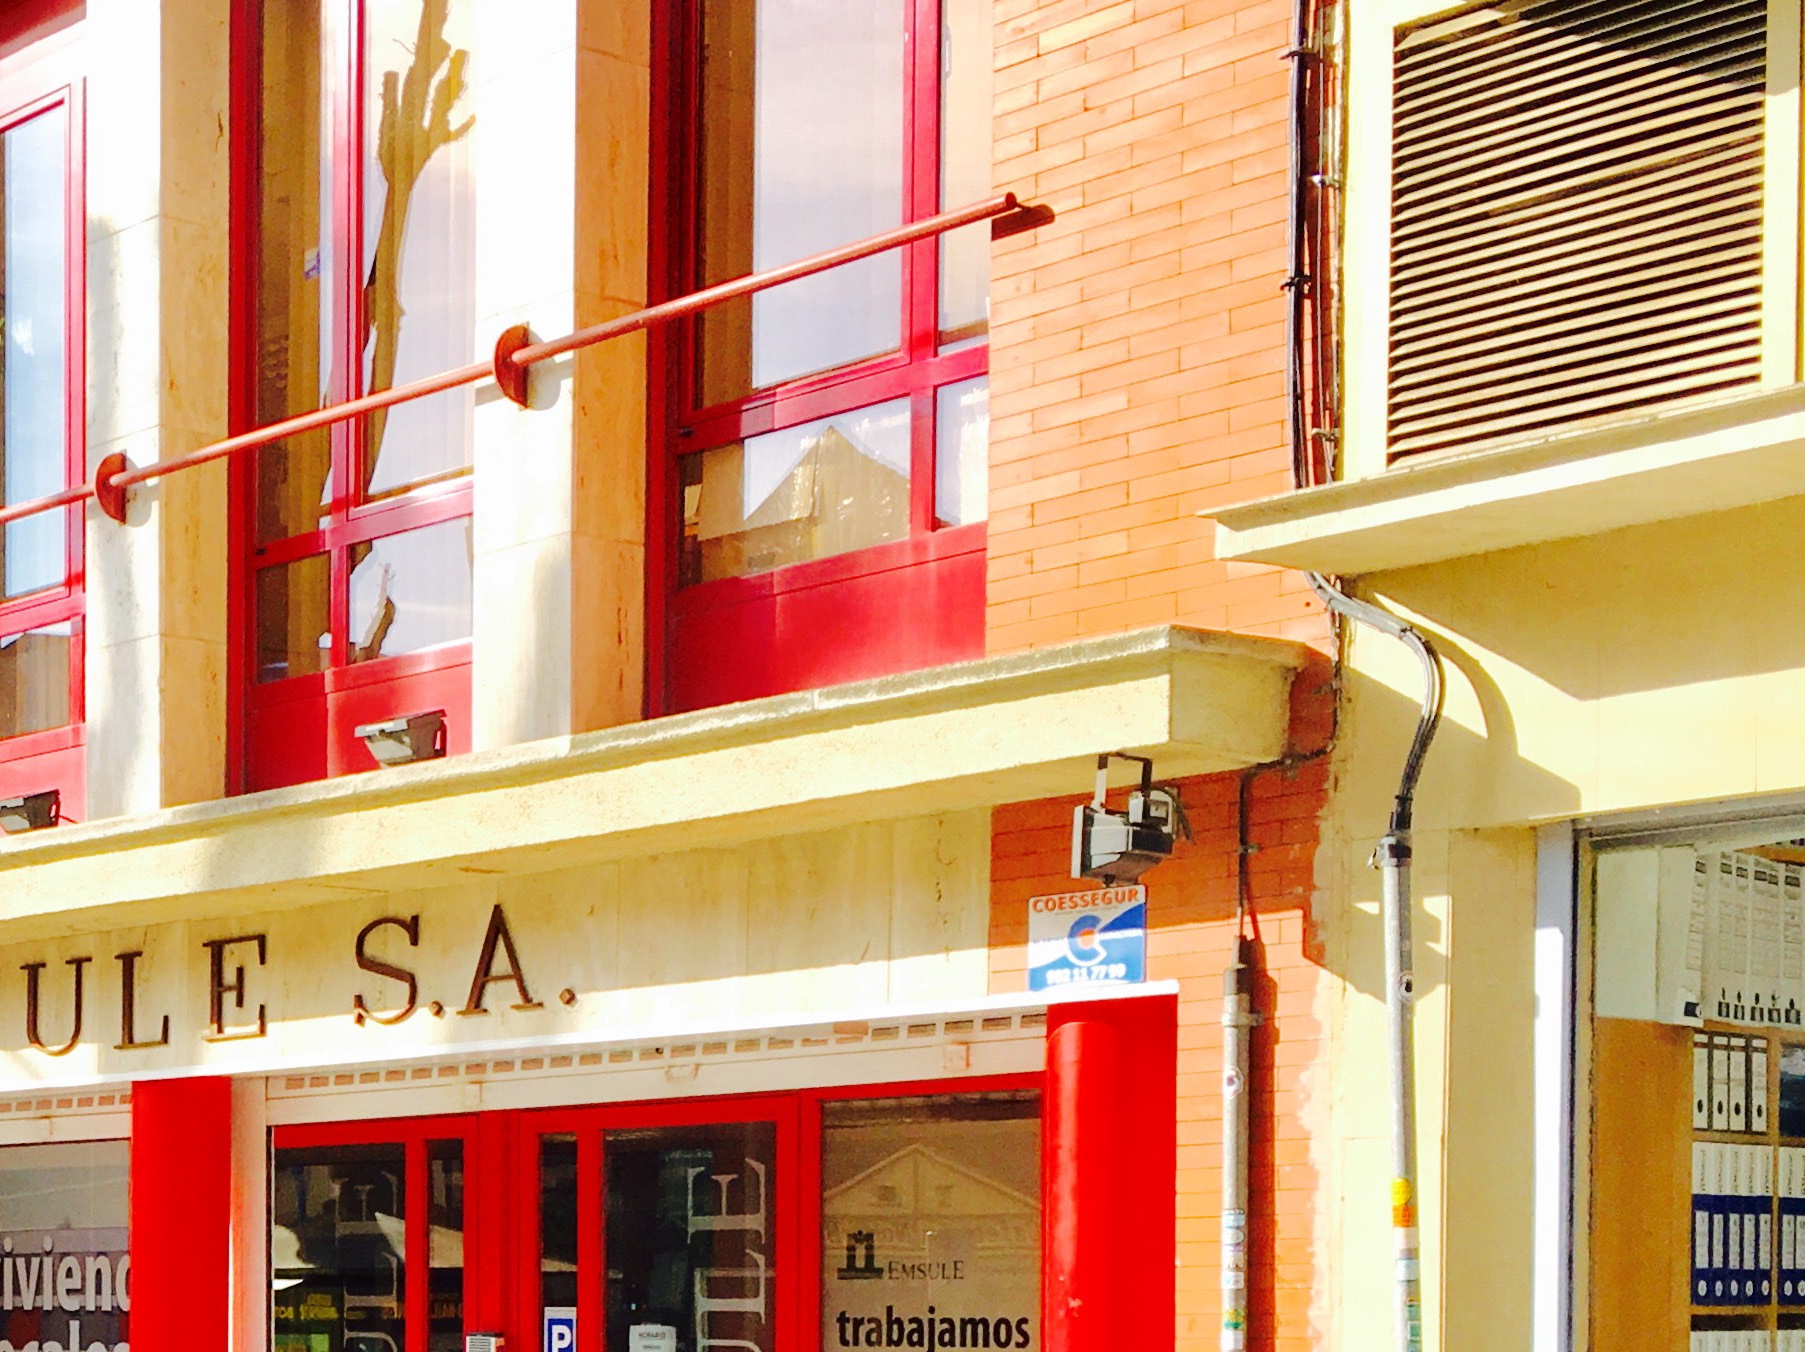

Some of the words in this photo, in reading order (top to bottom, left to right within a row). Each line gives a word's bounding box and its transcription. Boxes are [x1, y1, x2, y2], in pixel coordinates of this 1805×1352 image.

[1031, 888, 1139, 914] COESSEGUR
[353, 904, 578, 1027] S.A.
[888, 1260, 964, 1280] EMSULE
